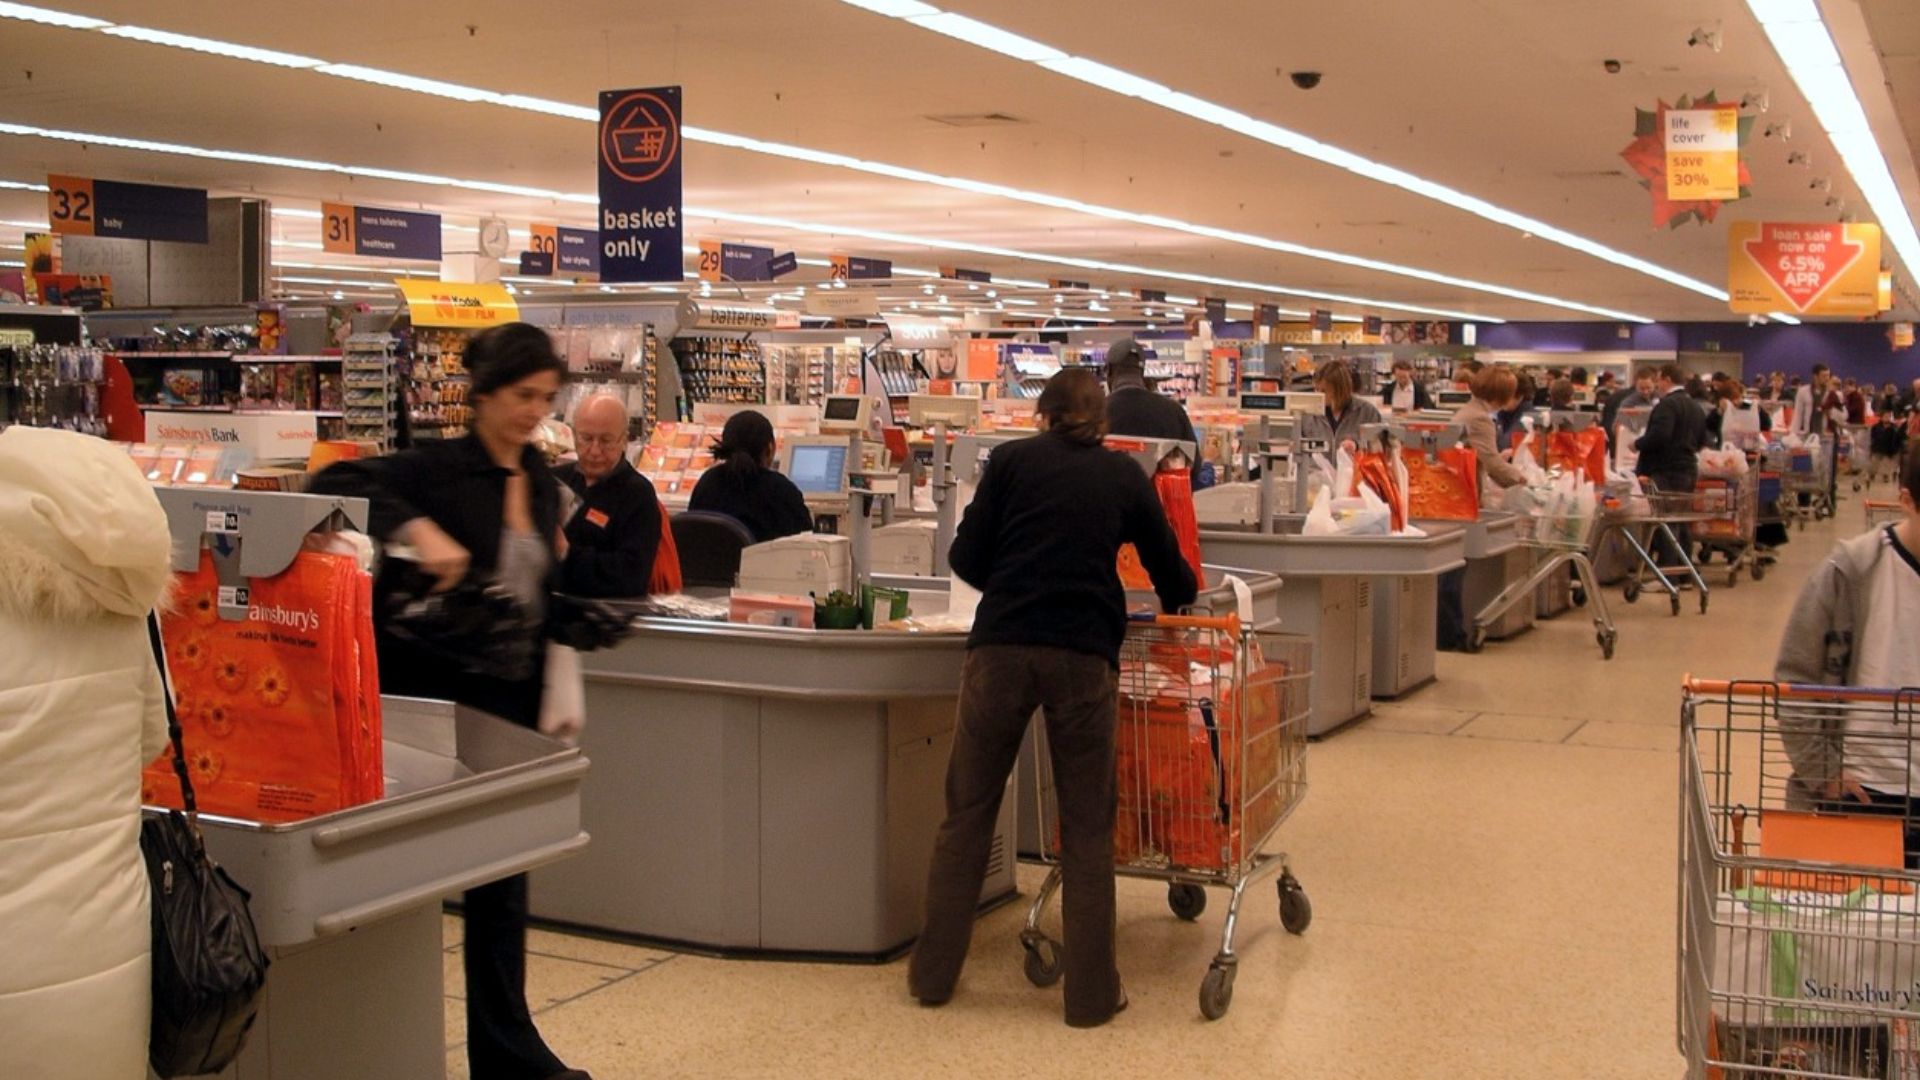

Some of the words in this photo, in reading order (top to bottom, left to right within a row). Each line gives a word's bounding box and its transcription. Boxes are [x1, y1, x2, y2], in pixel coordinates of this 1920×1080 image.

[1671, 118, 1690, 129] life
[1673, 134, 1705, 144] cover
[1673, 156, 1704, 167] save
[1674, 173, 1710, 186] 30%
[53, 188, 91, 222] 32
[103, 217, 123, 230] baby
[604, 206, 676, 229] basket
[328, 215, 350, 242] 31
[1773, 229, 1800, 240] loan
[1804, 229, 1832, 241] sale
[362, 239, 396, 250] healthcare
[532, 234, 555, 253] 30
[604, 236, 650, 262] only
[1779, 242, 1805, 253] now
[1808, 242, 1825, 253] on
[700, 250, 719, 272] 29
[1779, 255, 1825, 271] 6.5%
[832, 263, 848, 280] 28
[1784, 271, 1820, 287] APR
[452, 295, 483, 307] Kodak
[475, 309, 496, 319] FILM
[711, 308, 768, 327] batteries
[903, 325, 938, 339] SONY
[1271, 330, 1313, 344] froze
[1327, 330, 1364, 344] food
[157, 424, 212, 444] Sainsbury's
[211, 428, 240, 443] Bank
[249, 603, 319, 633] ainsbury's
[235, 631, 269, 642] making
